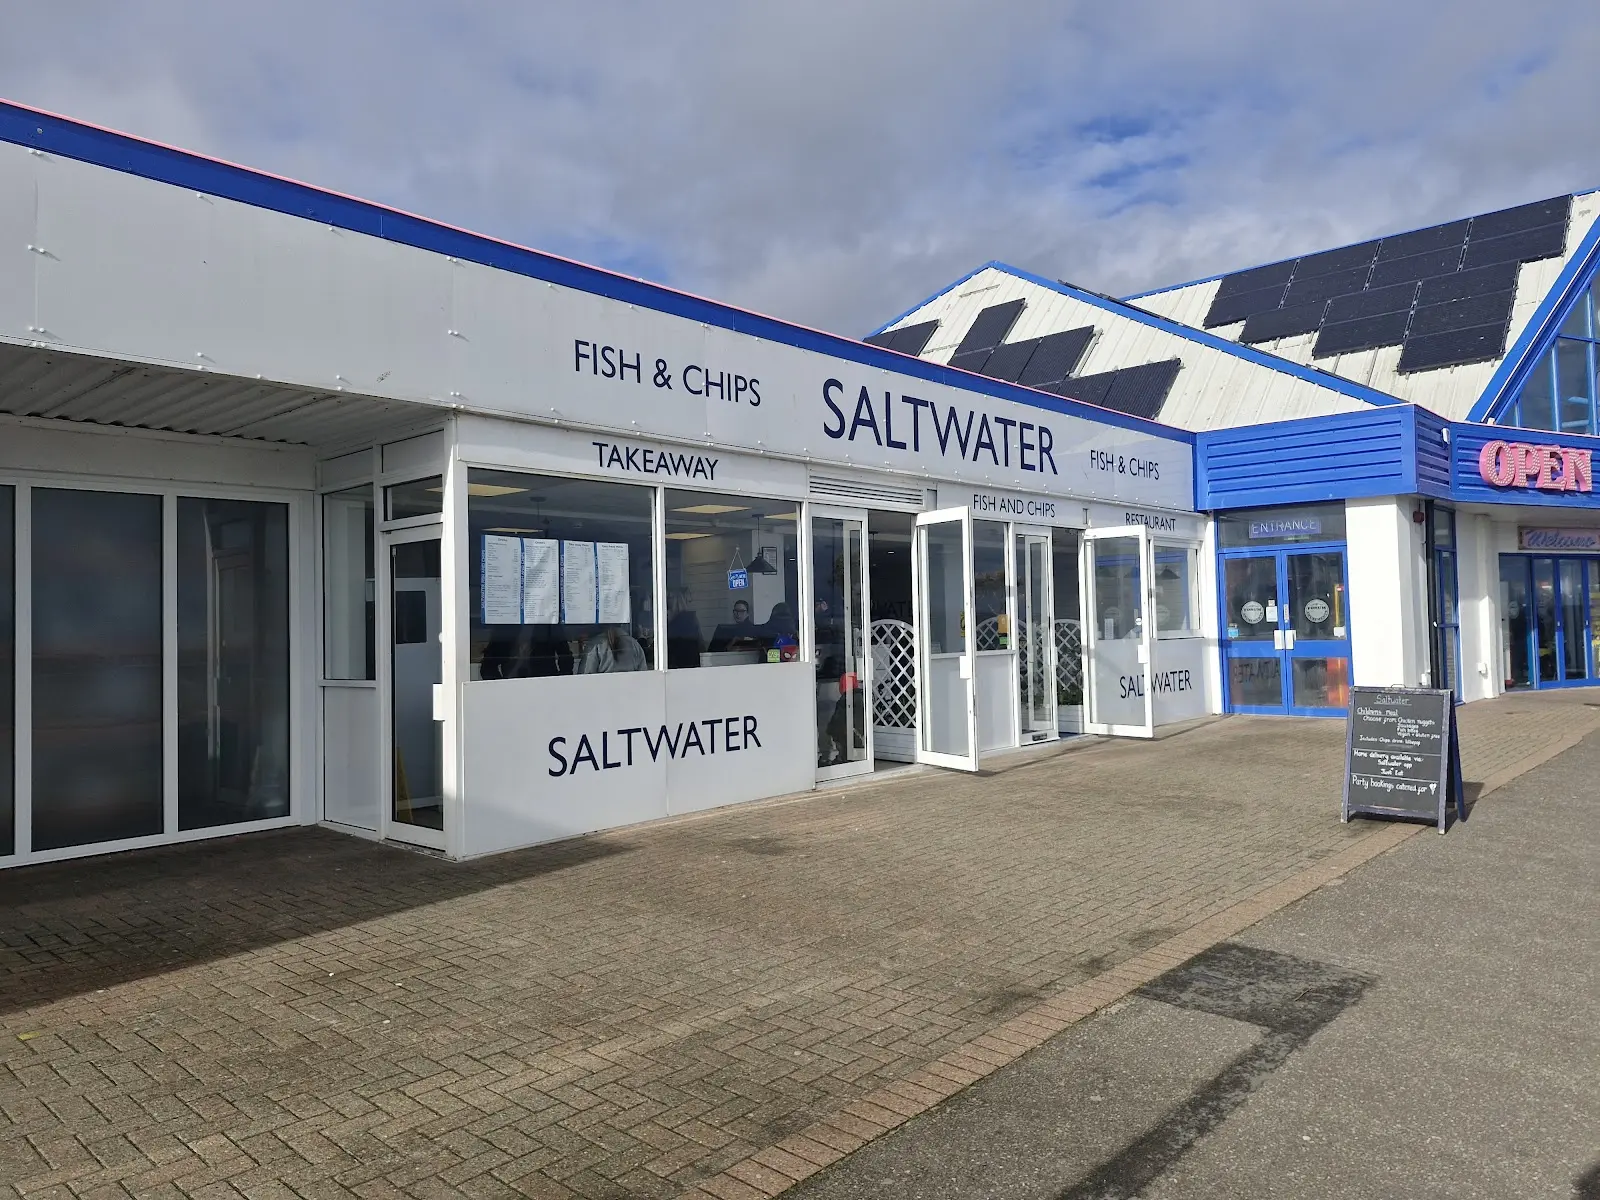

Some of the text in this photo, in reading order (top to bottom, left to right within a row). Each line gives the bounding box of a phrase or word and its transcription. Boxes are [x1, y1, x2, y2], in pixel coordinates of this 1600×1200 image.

[574, 339, 762, 408] FISH & CHIPS
[822, 378, 1059, 477] SALTWATER
[592, 441, 719, 482] TAKEAWAY
[1090, 449, 1160, 482] FISH & CHIPS
[1479, 440, 1592, 492] OPEN
[973, 493, 1056, 518] FISH AND CHIPS
[1125, 512, 1177, 532] RESTAURANT
[1251, 518, 1318, 535] ENTRANCE
[1525, 529, 1596, 548] Welcome
[732, 578, 744, 588] OPEN
[1120, 669, 1192, 699] SALWATER
[1377, 695, 1410, 705] Saltwater
[548, 715, 762, 778] SALTWATER
[1354, 750, 1368, 758] Home
[1370, 752, 1388, 760] delivery
[1352, 775, 1428, 796] Party bookings catered for
